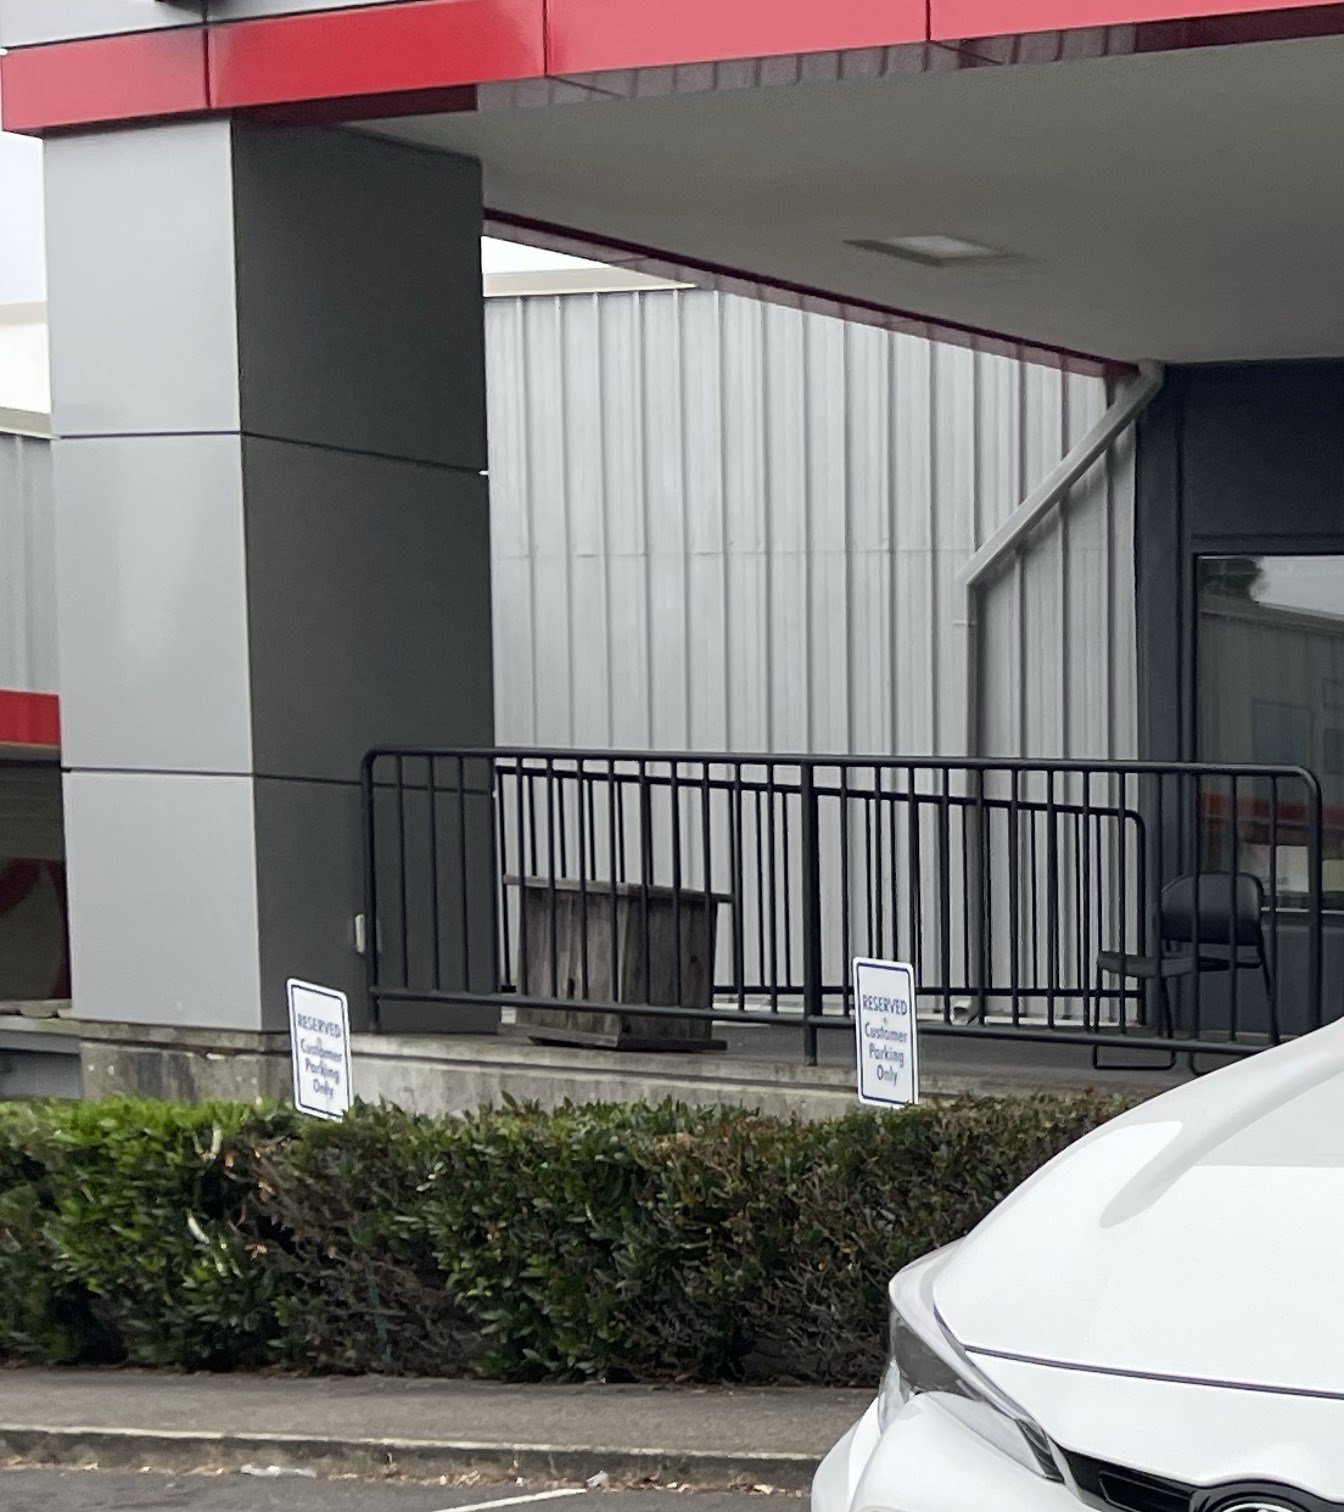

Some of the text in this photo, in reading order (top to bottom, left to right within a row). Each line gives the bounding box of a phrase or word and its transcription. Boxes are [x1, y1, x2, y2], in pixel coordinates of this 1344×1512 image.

[862, 994, 907, 1015] RESERVED
[865, 1021, 907, 1043] Customer
[869, 1042, 904, 1068] Parking
[877, 1064, 897, 1086] Only
